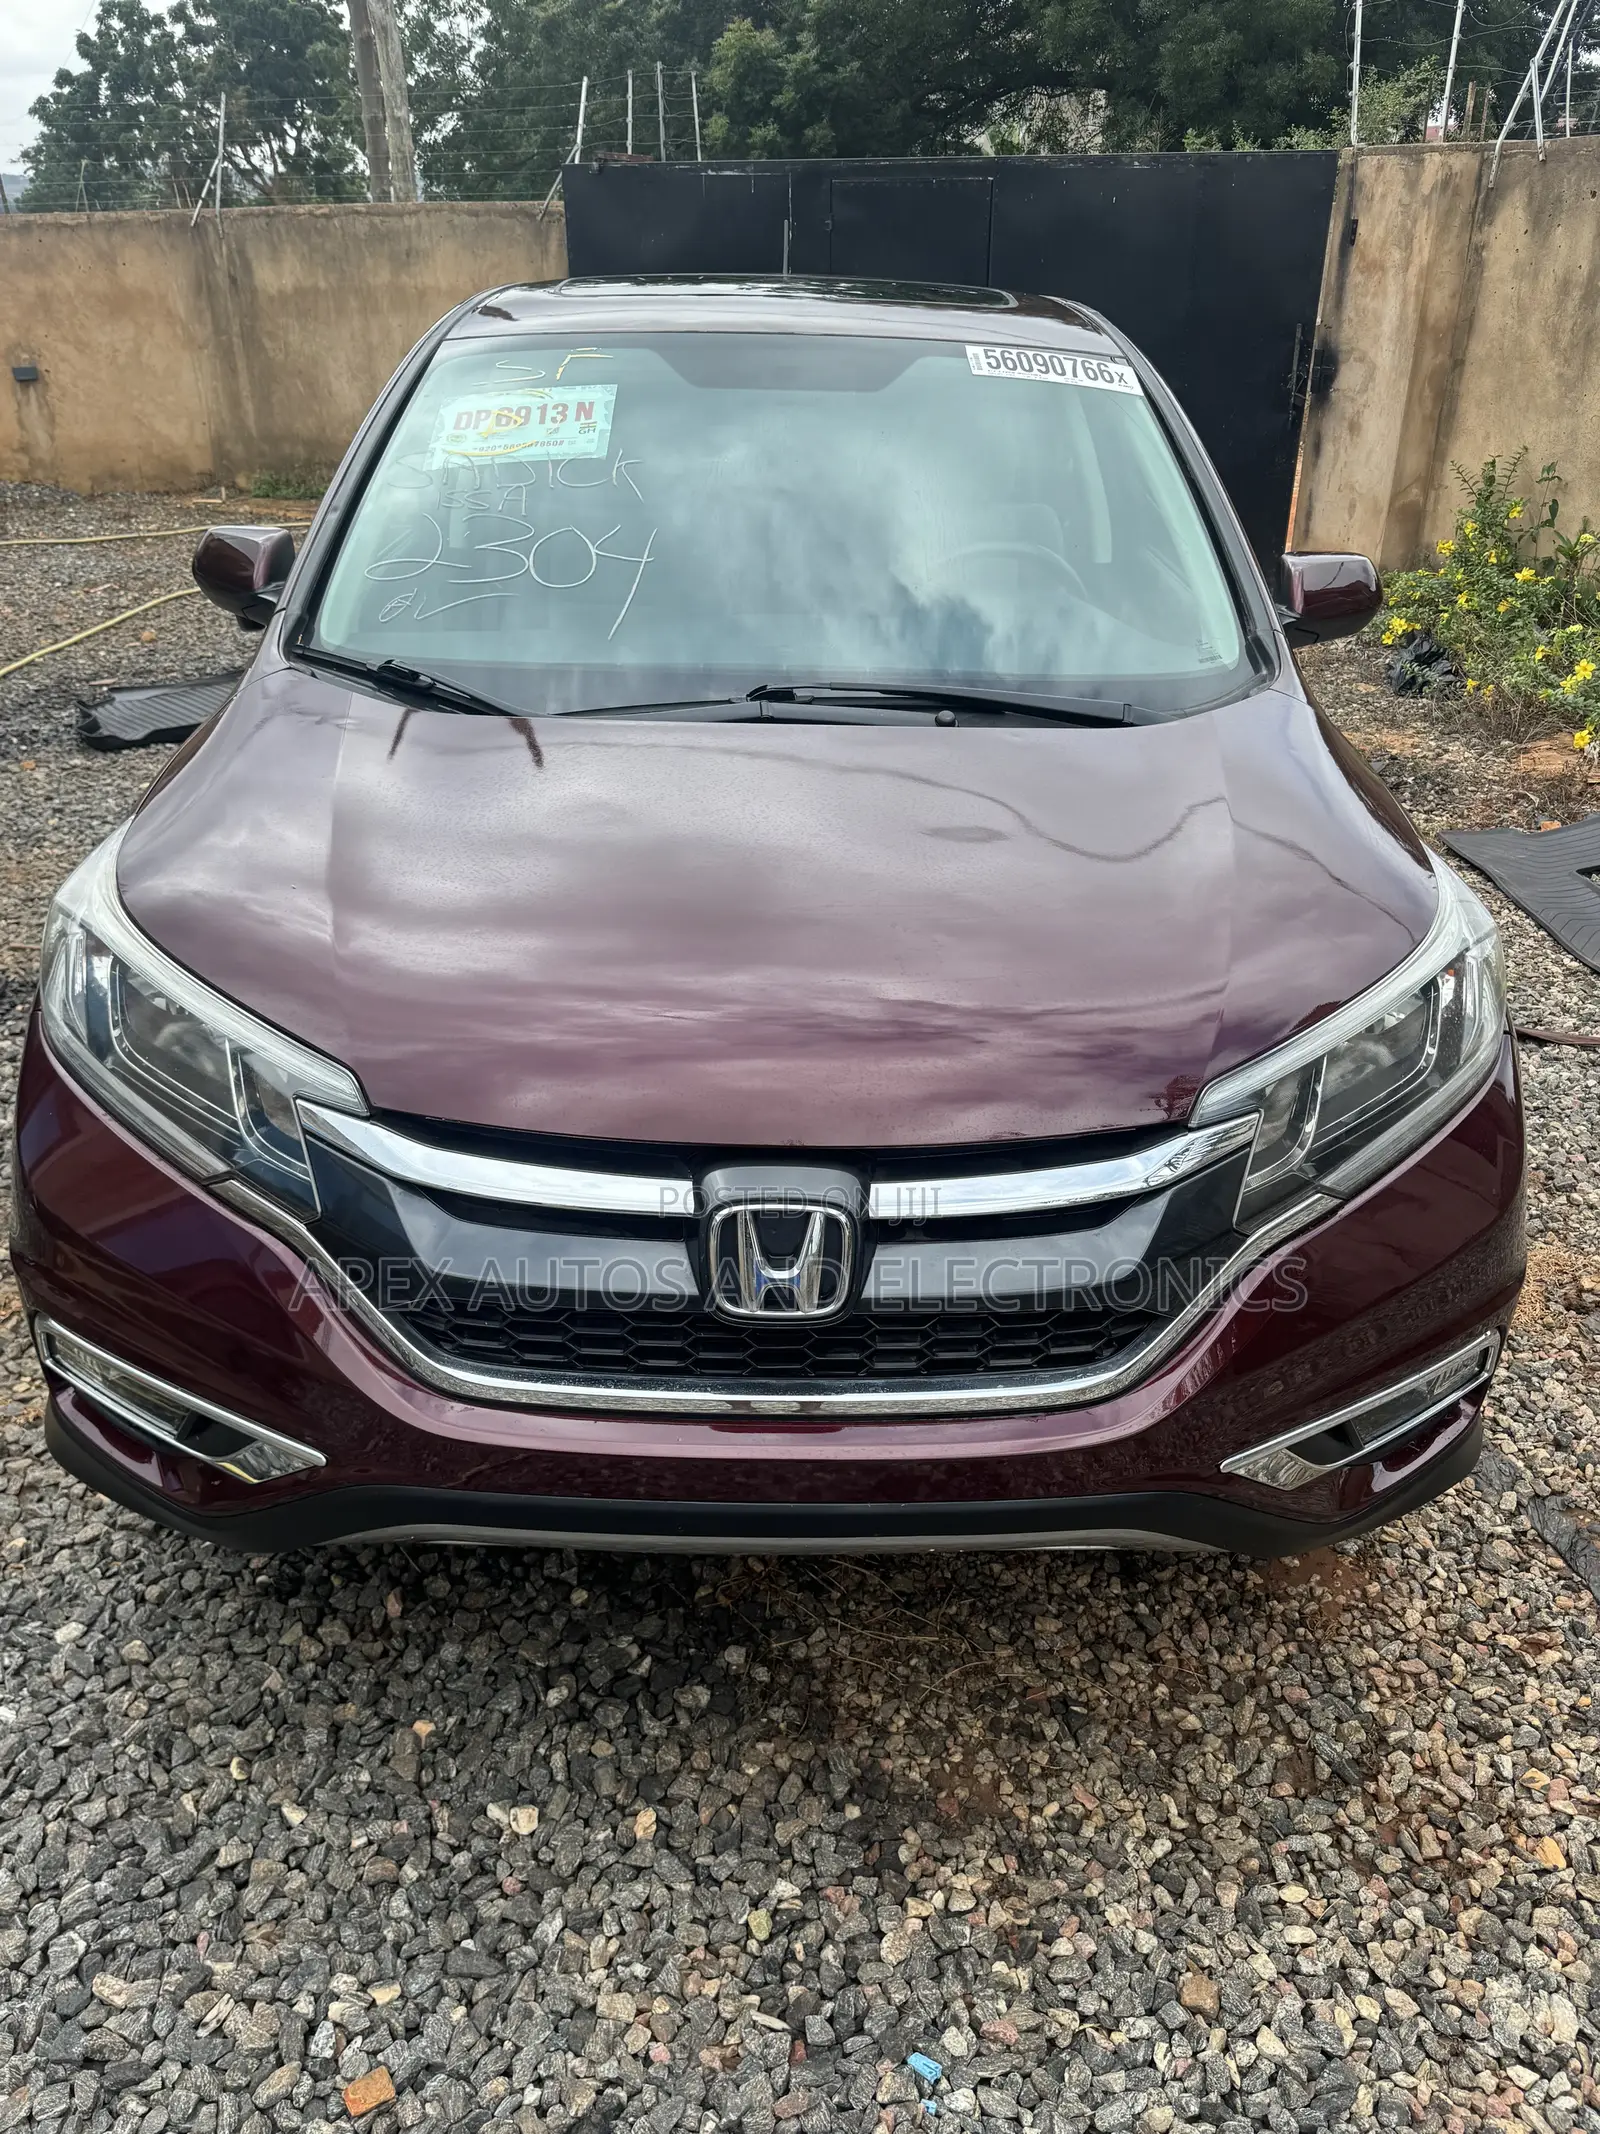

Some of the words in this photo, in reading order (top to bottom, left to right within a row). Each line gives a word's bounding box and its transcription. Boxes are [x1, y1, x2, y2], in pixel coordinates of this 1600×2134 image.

[984, 349, 1115, 384] 56090766
[452, 410, 491, 431] DP
[574, 401, 595, 422] N
[578, 427, 597, 435] GH
[364, 513, 658, 640] 2304
